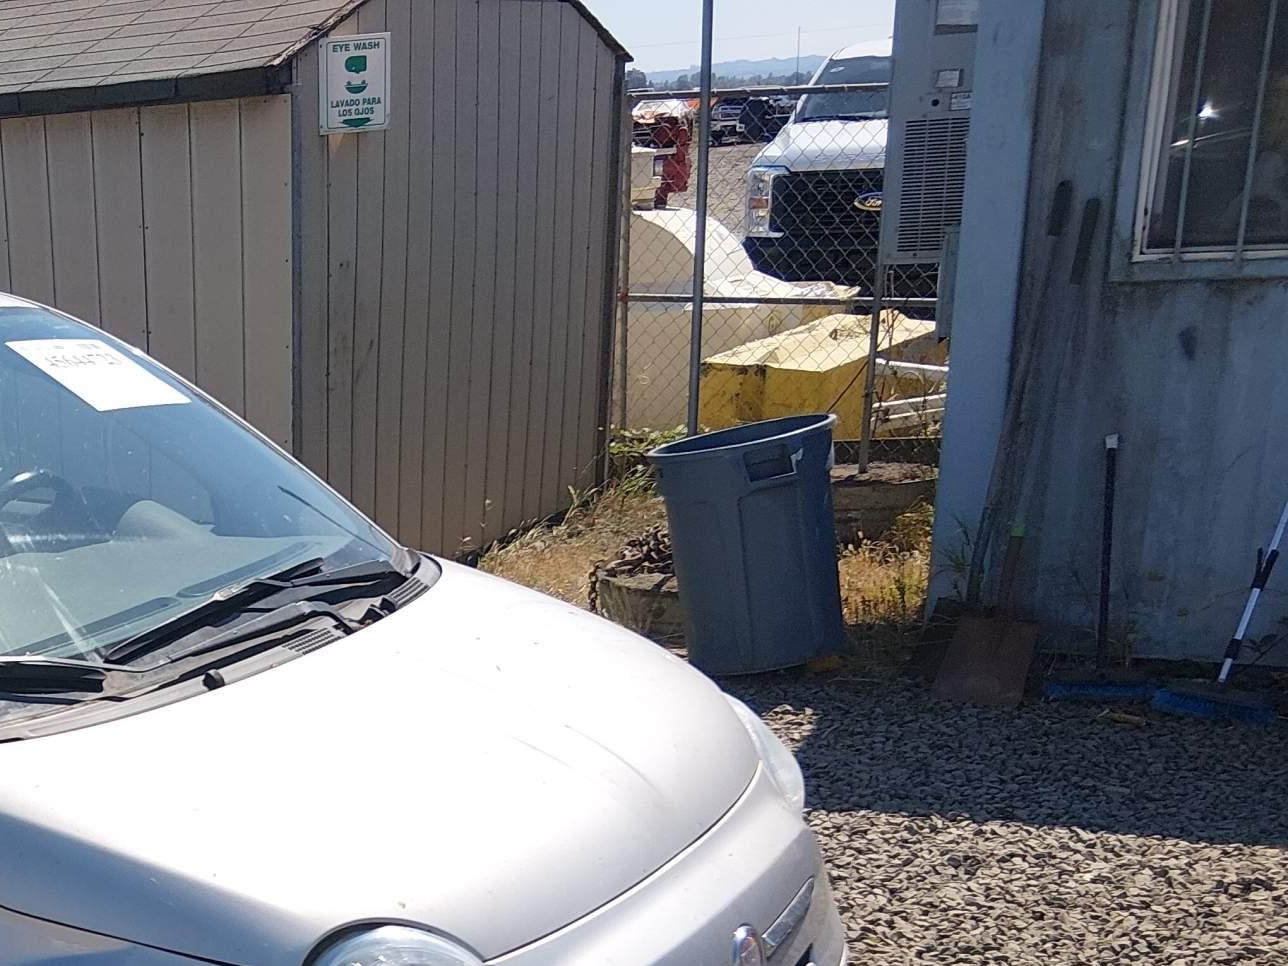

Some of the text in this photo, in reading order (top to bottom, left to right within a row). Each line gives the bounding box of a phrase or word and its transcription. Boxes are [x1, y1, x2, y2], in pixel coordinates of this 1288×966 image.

[332, 41, 381, 53] EYE WASH
[330, 96, 382, 109] LAVADO PARA
[338, 106, 375, 117] LOS OJOS
